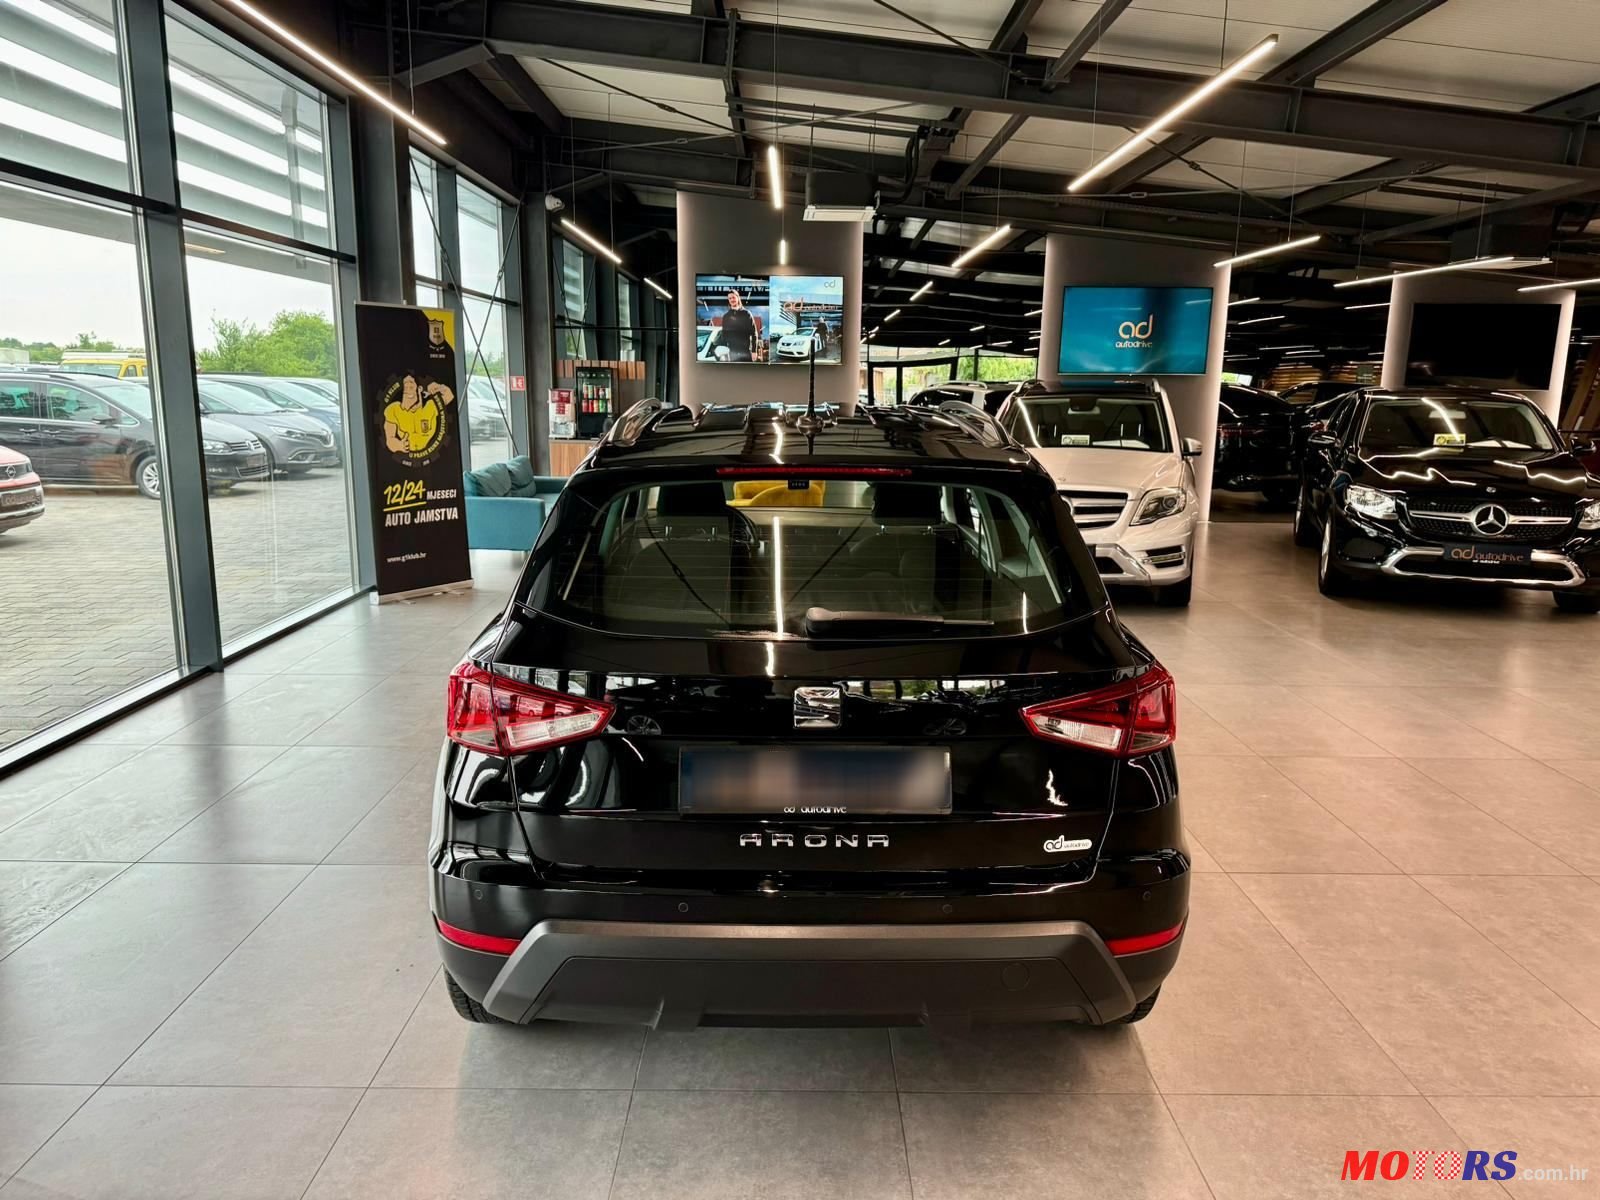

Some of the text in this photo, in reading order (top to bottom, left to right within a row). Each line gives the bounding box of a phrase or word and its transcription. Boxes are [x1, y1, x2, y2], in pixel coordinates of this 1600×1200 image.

[1118, 314, 1153, 339] ad
[1115, 340, 1153, 348] autodrive
[383, 479, 457, 505] 12/24 MJESECI
[385, 507, 459, 528] AUTO JAMSTVA
[1451, 545, 1475, 560] ad
[739, 833, 890, 849] ARONA
